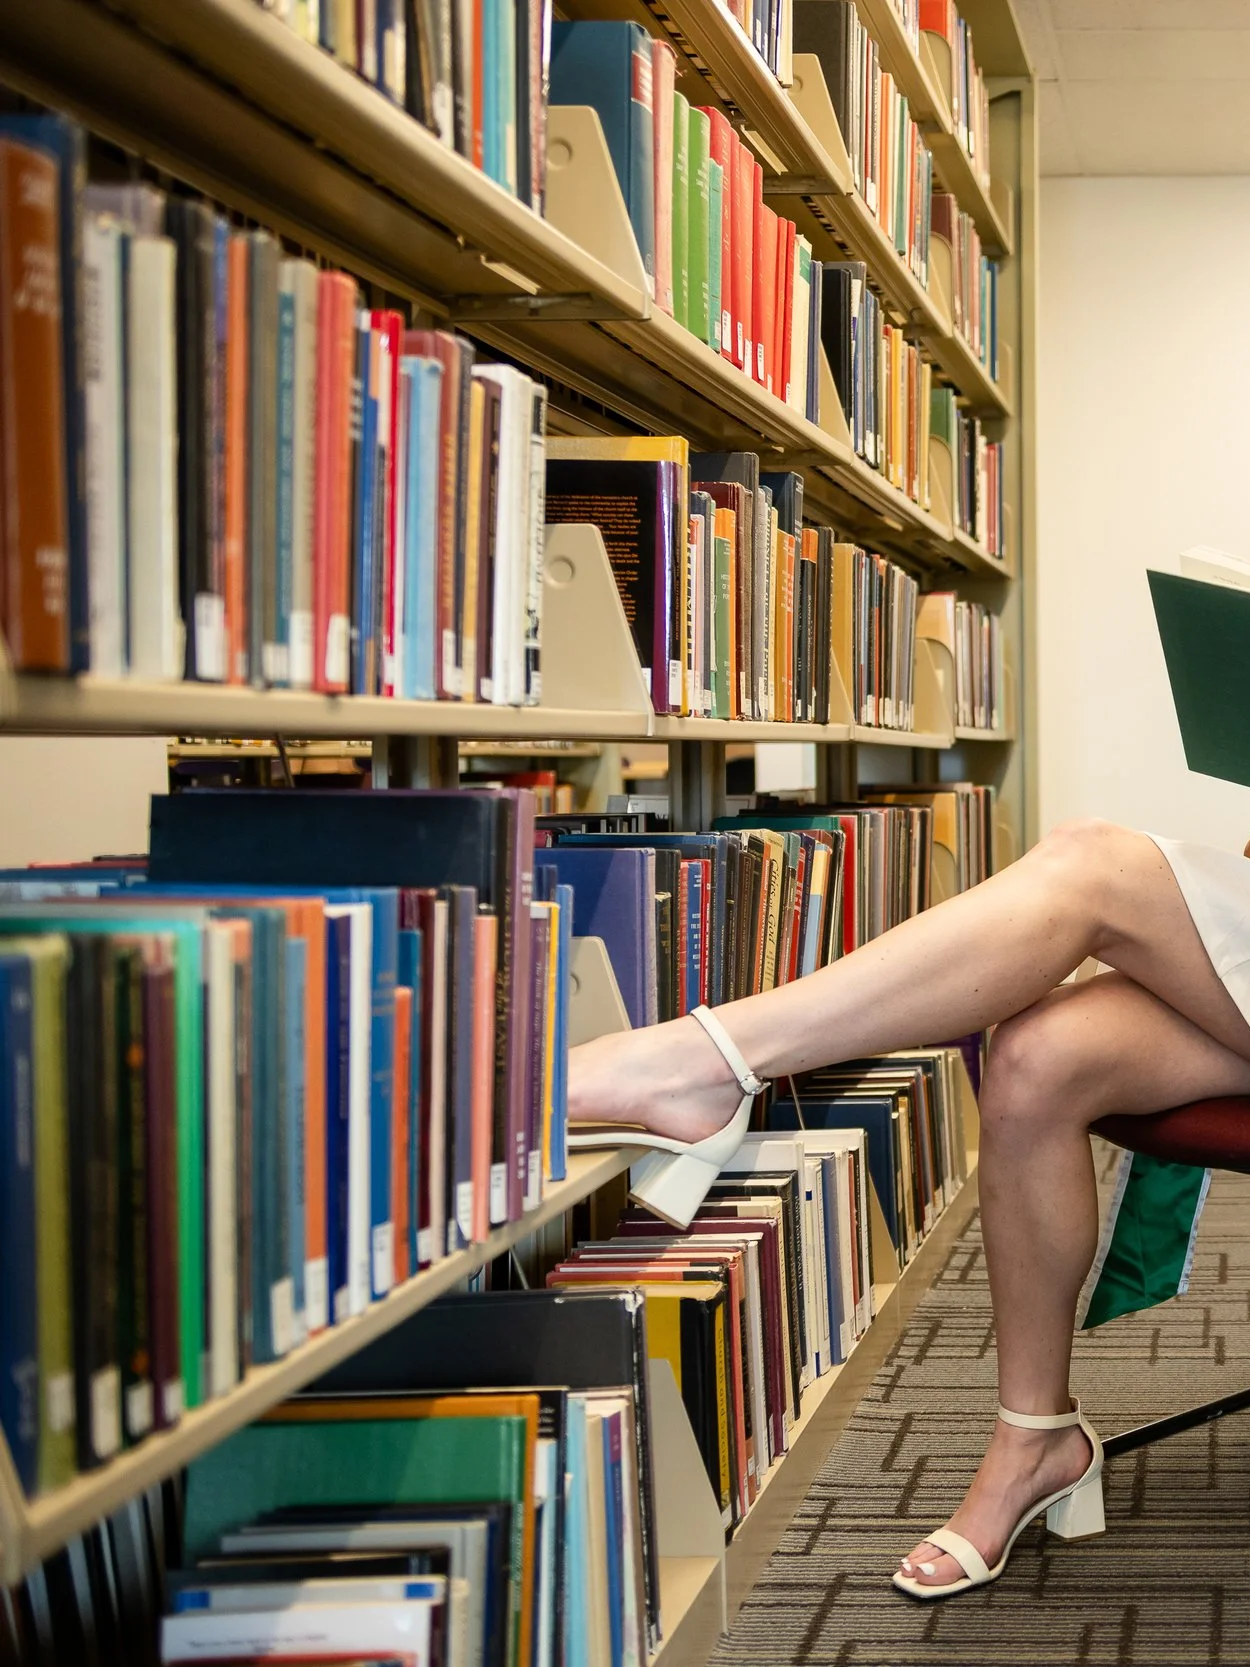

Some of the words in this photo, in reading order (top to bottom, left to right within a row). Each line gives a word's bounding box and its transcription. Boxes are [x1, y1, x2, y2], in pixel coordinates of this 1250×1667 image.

[769, 858, 779, 896] Cities
[768, 913, 776, 945] God
[720, 1420, 728, 1478] Society
